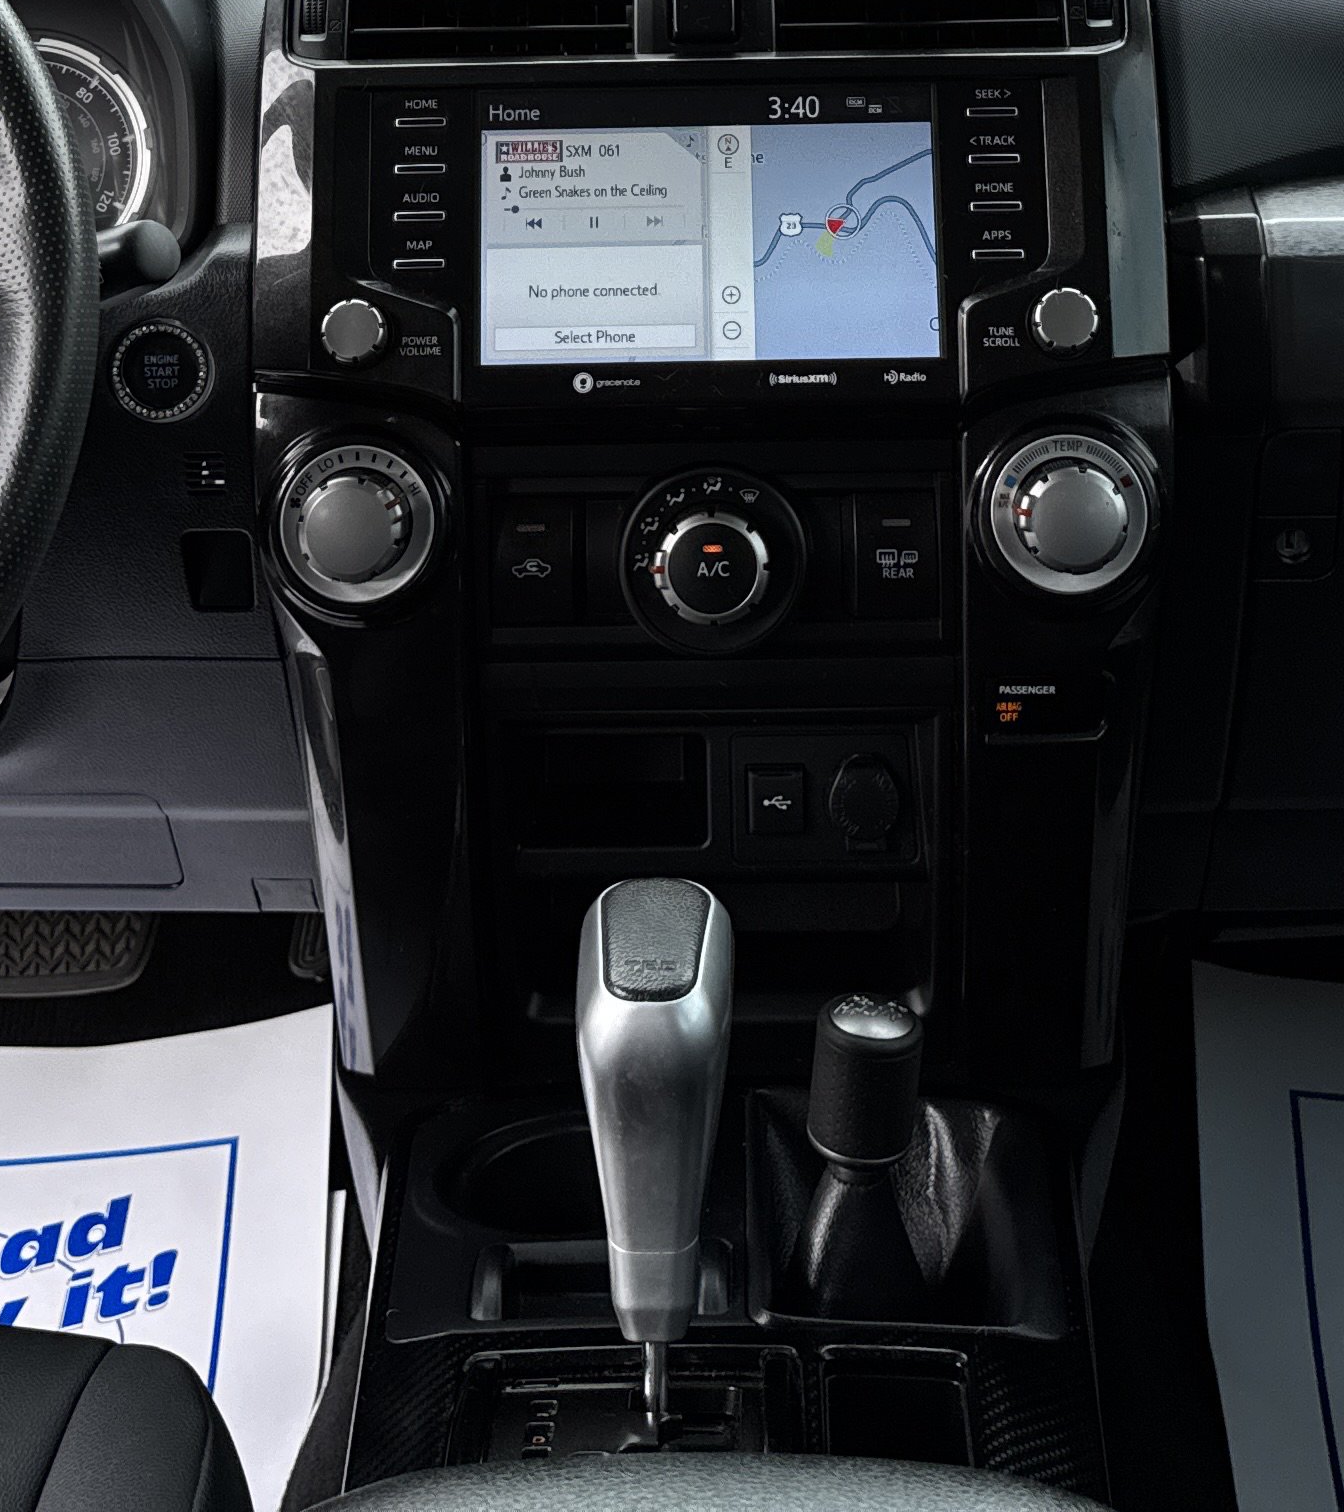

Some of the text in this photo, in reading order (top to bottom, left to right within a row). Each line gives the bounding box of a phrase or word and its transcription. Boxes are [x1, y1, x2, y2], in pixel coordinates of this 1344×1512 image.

[75, 87, 94, 104] 80
[975, 89, 1002, 99] SEEK
[405, 99, 438, 109] HOME
[768, 95, 820, 119] 3:40
[488, 104, 541, 122] Home
[107, 131, 122, 156] 100
[979, 136, 1016, 146] TRACK
[404, 145, 438, 156] MENU
[510, 141, 559, 154] WILLIE'S
[565, 143, 621, 158] SXM 061
[500, 153, 560, 163] ROADHOUSE
[724, 157, 733, 169] E
[518, 165, 586, 181] Johnny Bush
[518, 183, 668, 199] Green Snakes on the Ceiling
[974, 183, 1014, 193] PHONE
[95, 189, 115, 213] 120
[402, 192, 440, 204] AUDIO
[982, 230, 1012, 241] APPS
[406, 240, 433, 251] MAP
[528, 285, 548, 299] No
[551, 284, 590, 301] phone
[554, 329, 636, 345] Select Phone
[988, 326, 1015, 336] TUNE
[401, 336, 439, 345] POWER
[983, 337, 1021, 347] SCROLL
[399, 346, 442, 356] VOLUME
[143, 353, 180, 365] ENGINE
[143, 366, 180, 378] START
[899, 372, 927, 383] Radio
[147, 378, 179, 389] STOP
[595, 377, 642, 387] gracenote
[1052, 439, 1083, 453] TEMP
[316, 457, 335, 473] LO
[295, 471, 315, 497] OFF
[408, 481, 422, 496] HI
[697, 561, 731, 577] A/C
[882, 568, 915, 579] REAR
[999, 685, 1056, 695] PASSENGER
[999, 712, 1019, 723] OFF
[57, 1247, 179, 1333] it!
